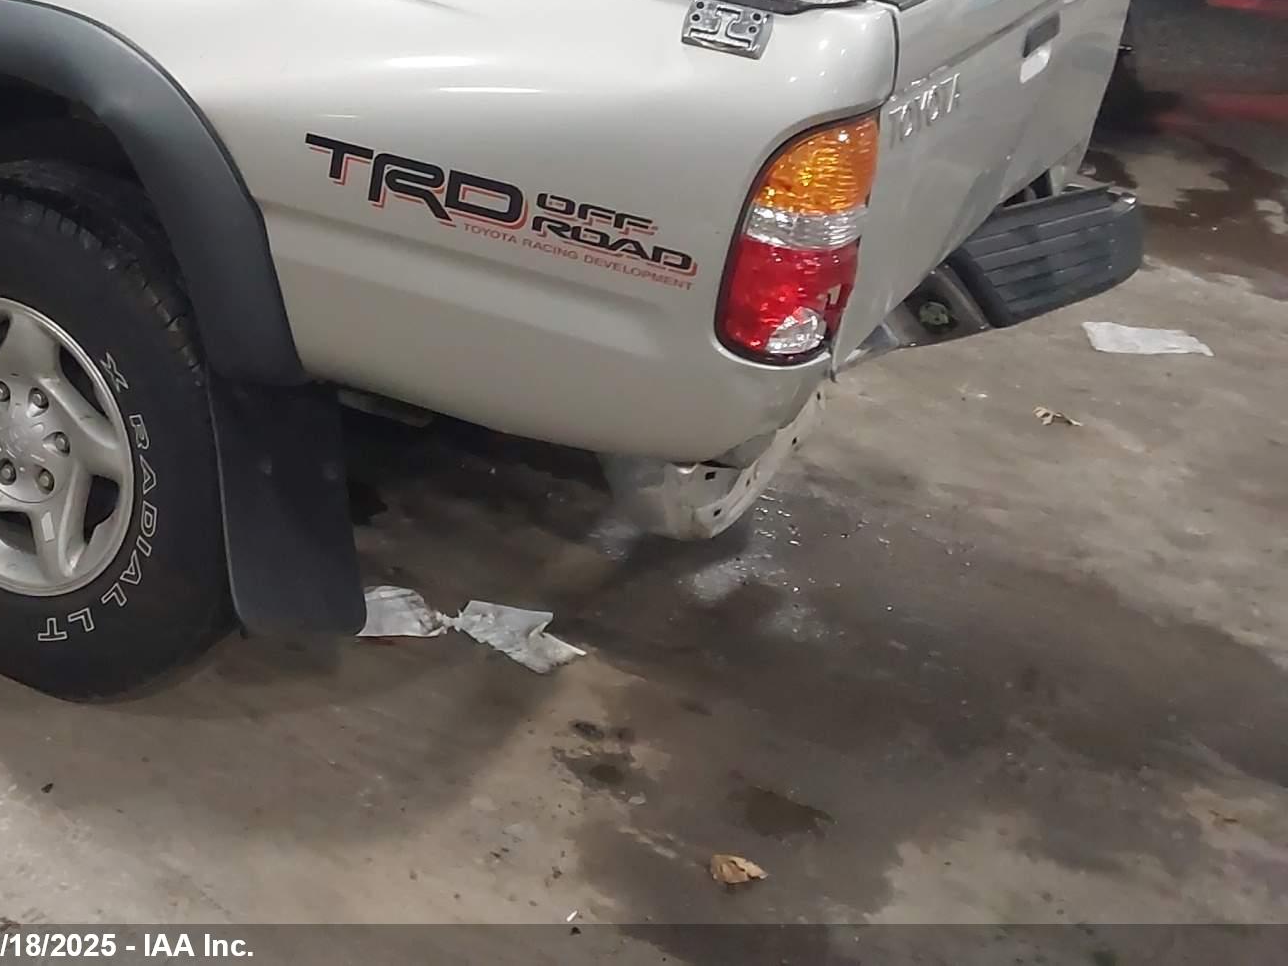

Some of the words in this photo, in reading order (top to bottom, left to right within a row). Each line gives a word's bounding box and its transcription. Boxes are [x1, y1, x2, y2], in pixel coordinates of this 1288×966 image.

[305, 132, 528, 230] TRD
[536, 192, 658, 236] OFF
[463, 222, 518, 245] TOYOTA
[522, 237, 578, 260] RACING
[583, 253, 694, 291] DEVELOPMENT
[531, 216, 697, 277] ROAD
[101, 413, 158, 607] RADIAL
[38, 608, 96, 642] LT
